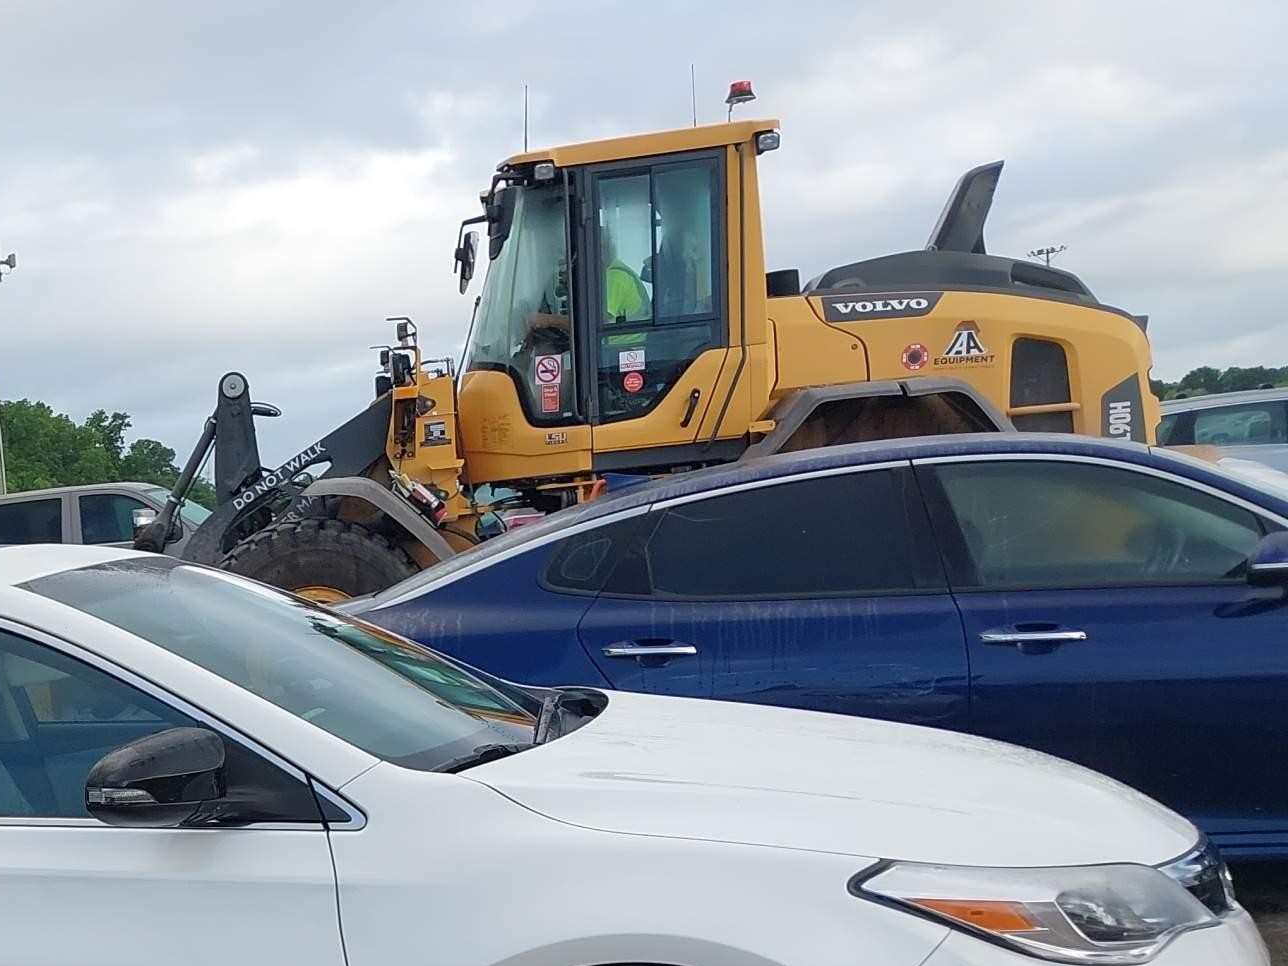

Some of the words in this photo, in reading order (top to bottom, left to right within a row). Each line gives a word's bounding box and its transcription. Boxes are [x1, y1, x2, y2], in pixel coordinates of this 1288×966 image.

[832, 298, 929, 314] VOLVO
[933, 354, 995, 366] EQUIPMENT
[232, 490, 255, 511] DO
[255, 470, 285, 493] NOT
[285, 442, 328, 473] WALK
